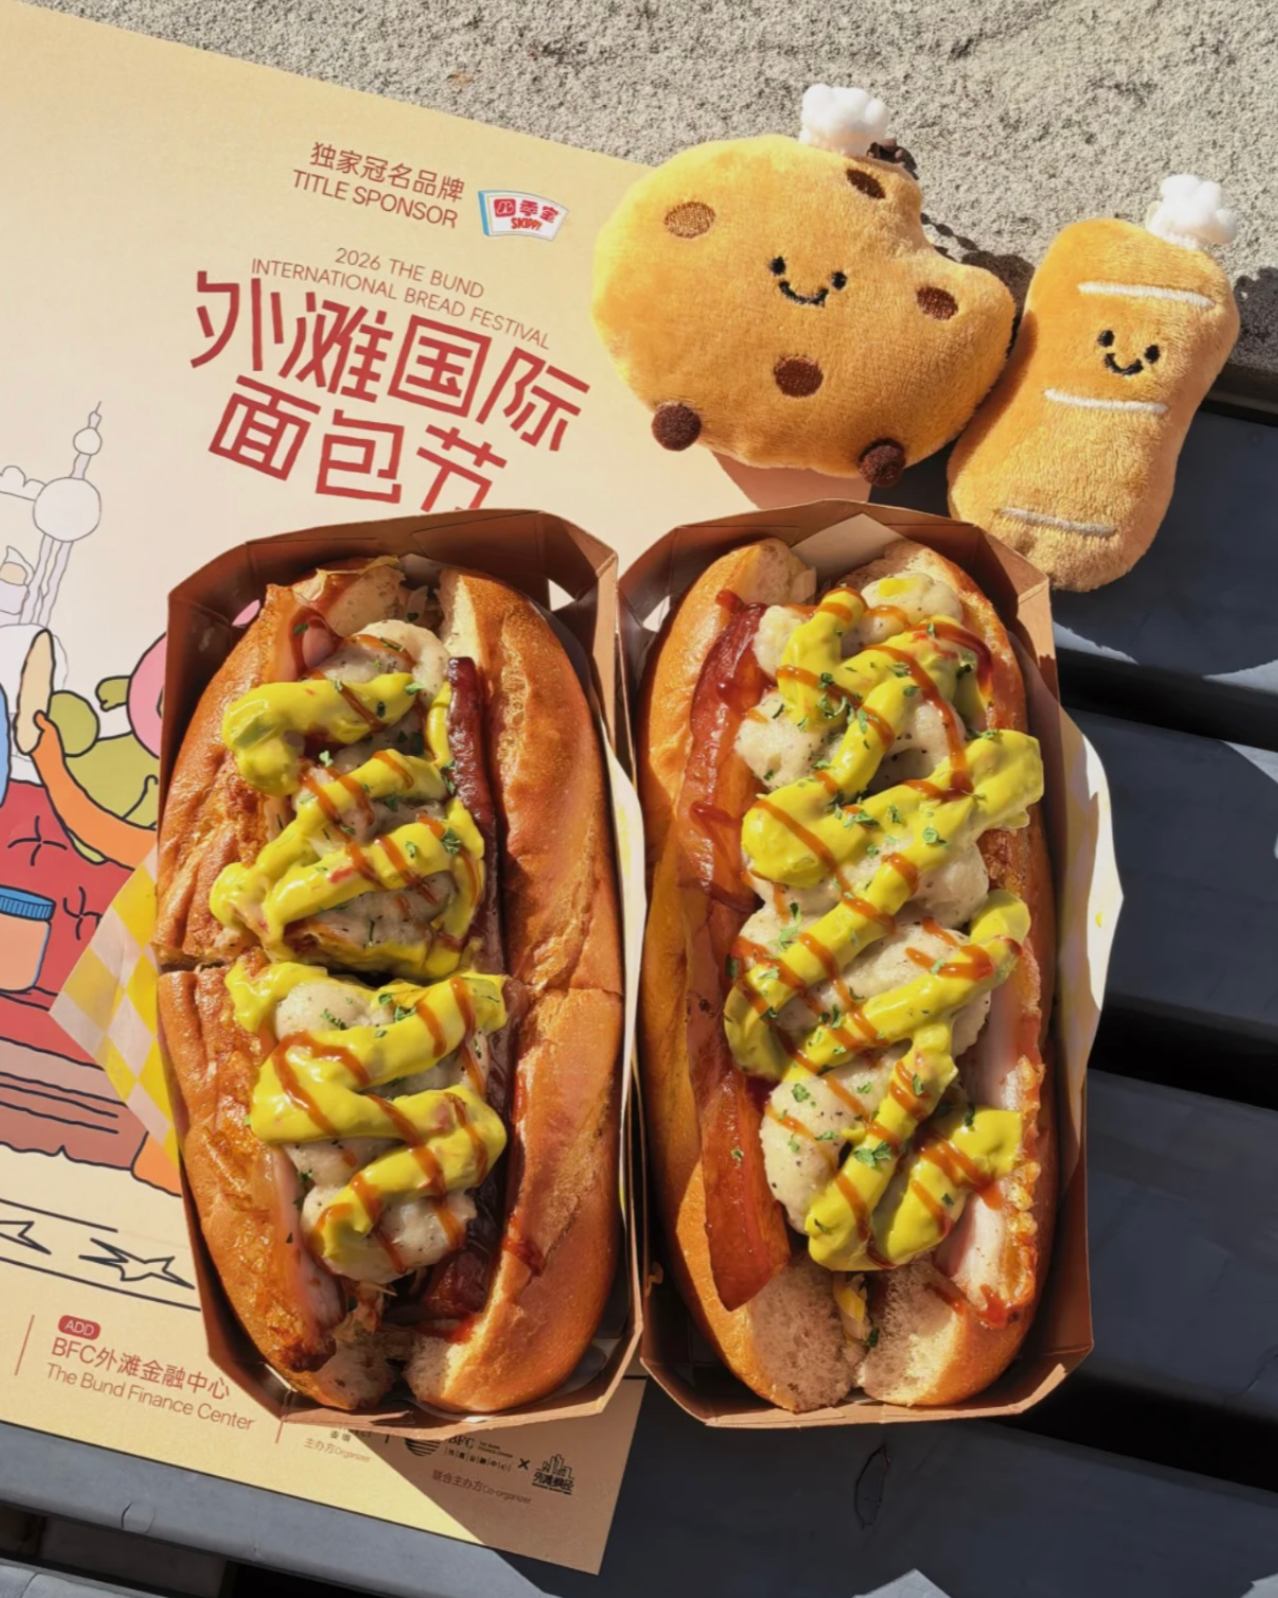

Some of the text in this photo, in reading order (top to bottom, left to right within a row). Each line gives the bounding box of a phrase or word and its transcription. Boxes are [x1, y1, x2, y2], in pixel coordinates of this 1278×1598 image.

[292, 169, 460, 229] TITLE SPONSOR
[309, 141, 466, 203] 独家冠名品牌
[251, 258, 550, 350] INTERNATIONAL BREAD FESTIVAL
[334, 247, 485, 299] 2026 THE BUND
[190, 270, 591, 452] 外滩国际
[208, 374, 508, 512] 面包节
[64, 1319, 95, 1337] ADD
[47, 1362, 255, 1431] The Bund Finance Center
[51, 1337, 230, 1400] BFC外滩金融中心
